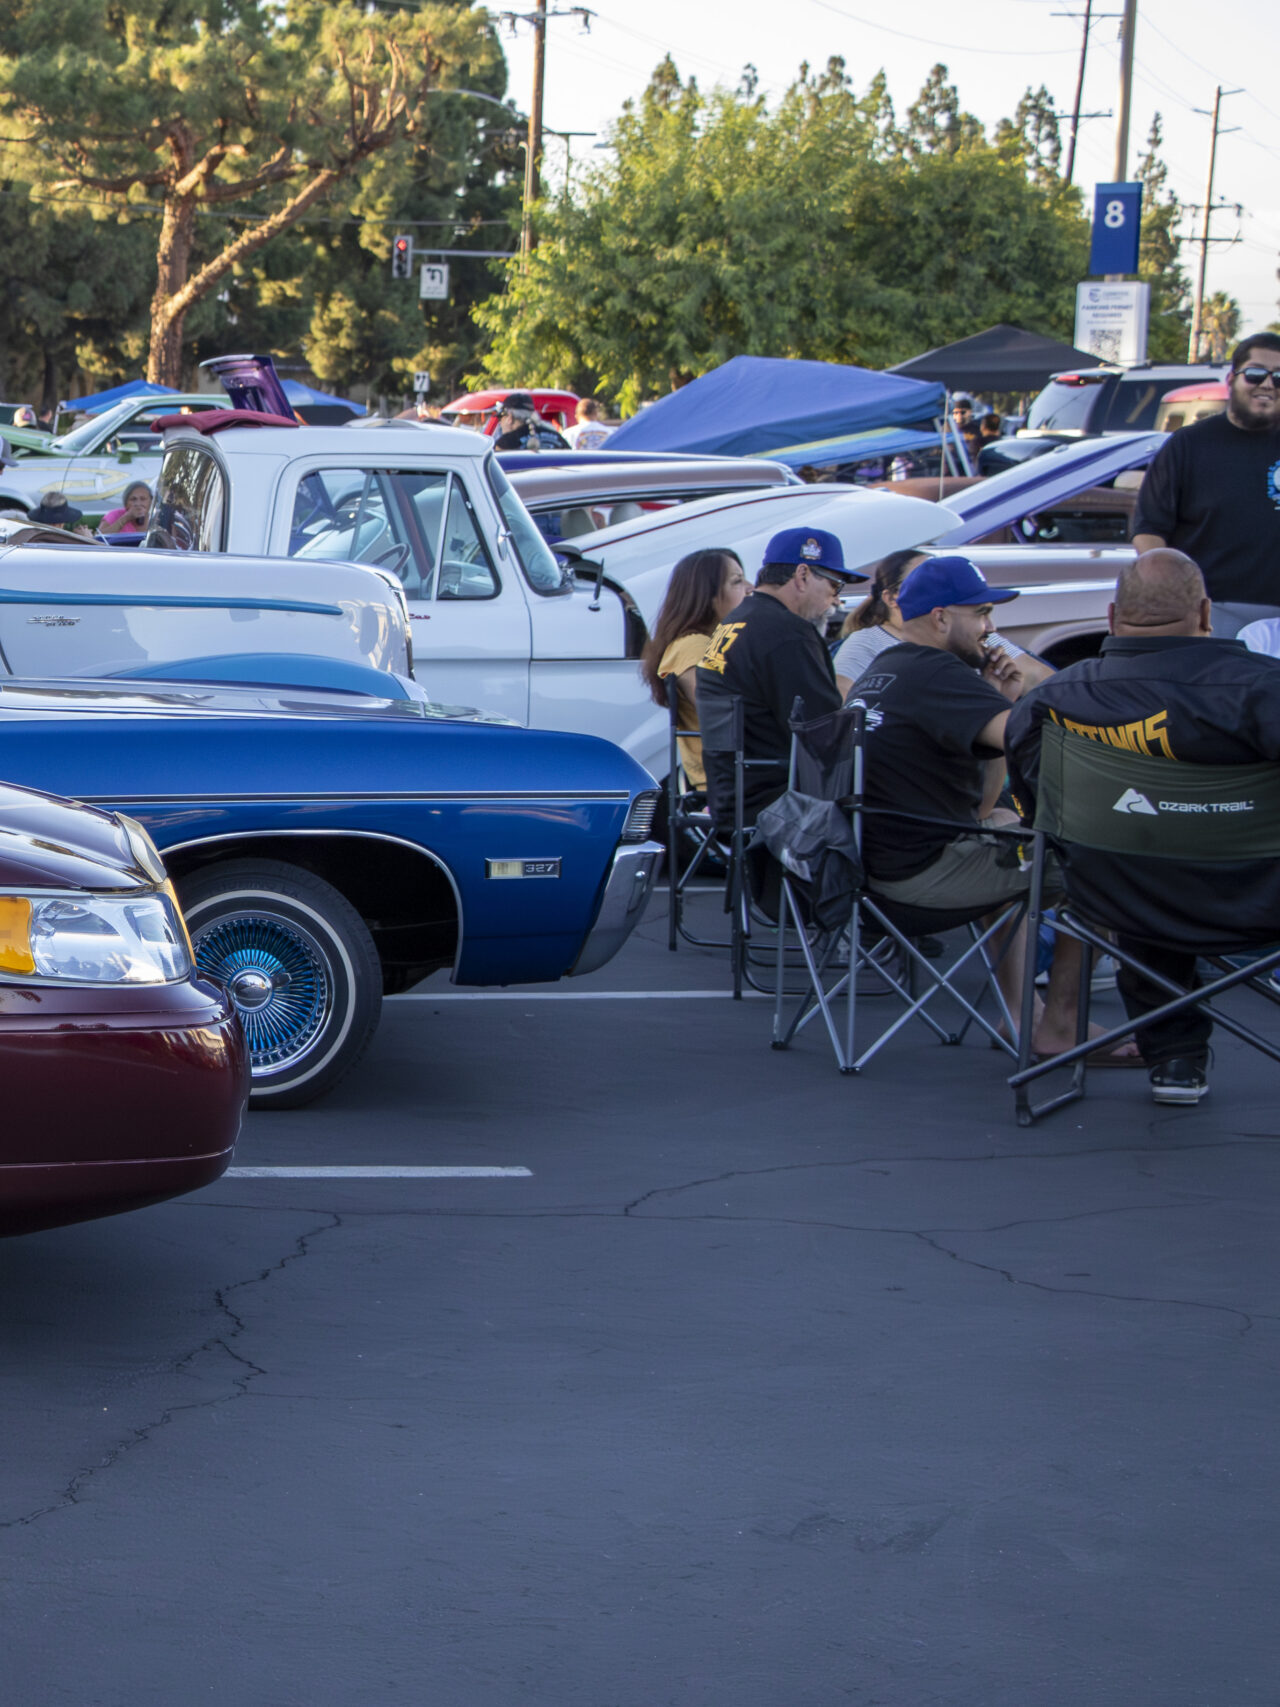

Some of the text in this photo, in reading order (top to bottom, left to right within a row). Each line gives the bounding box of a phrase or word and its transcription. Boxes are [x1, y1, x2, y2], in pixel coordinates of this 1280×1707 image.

[1104, 200, 1125, 228] 8
[1049, 709, 1178, 761] TINOS
[525, 863, 554, 874] 327
